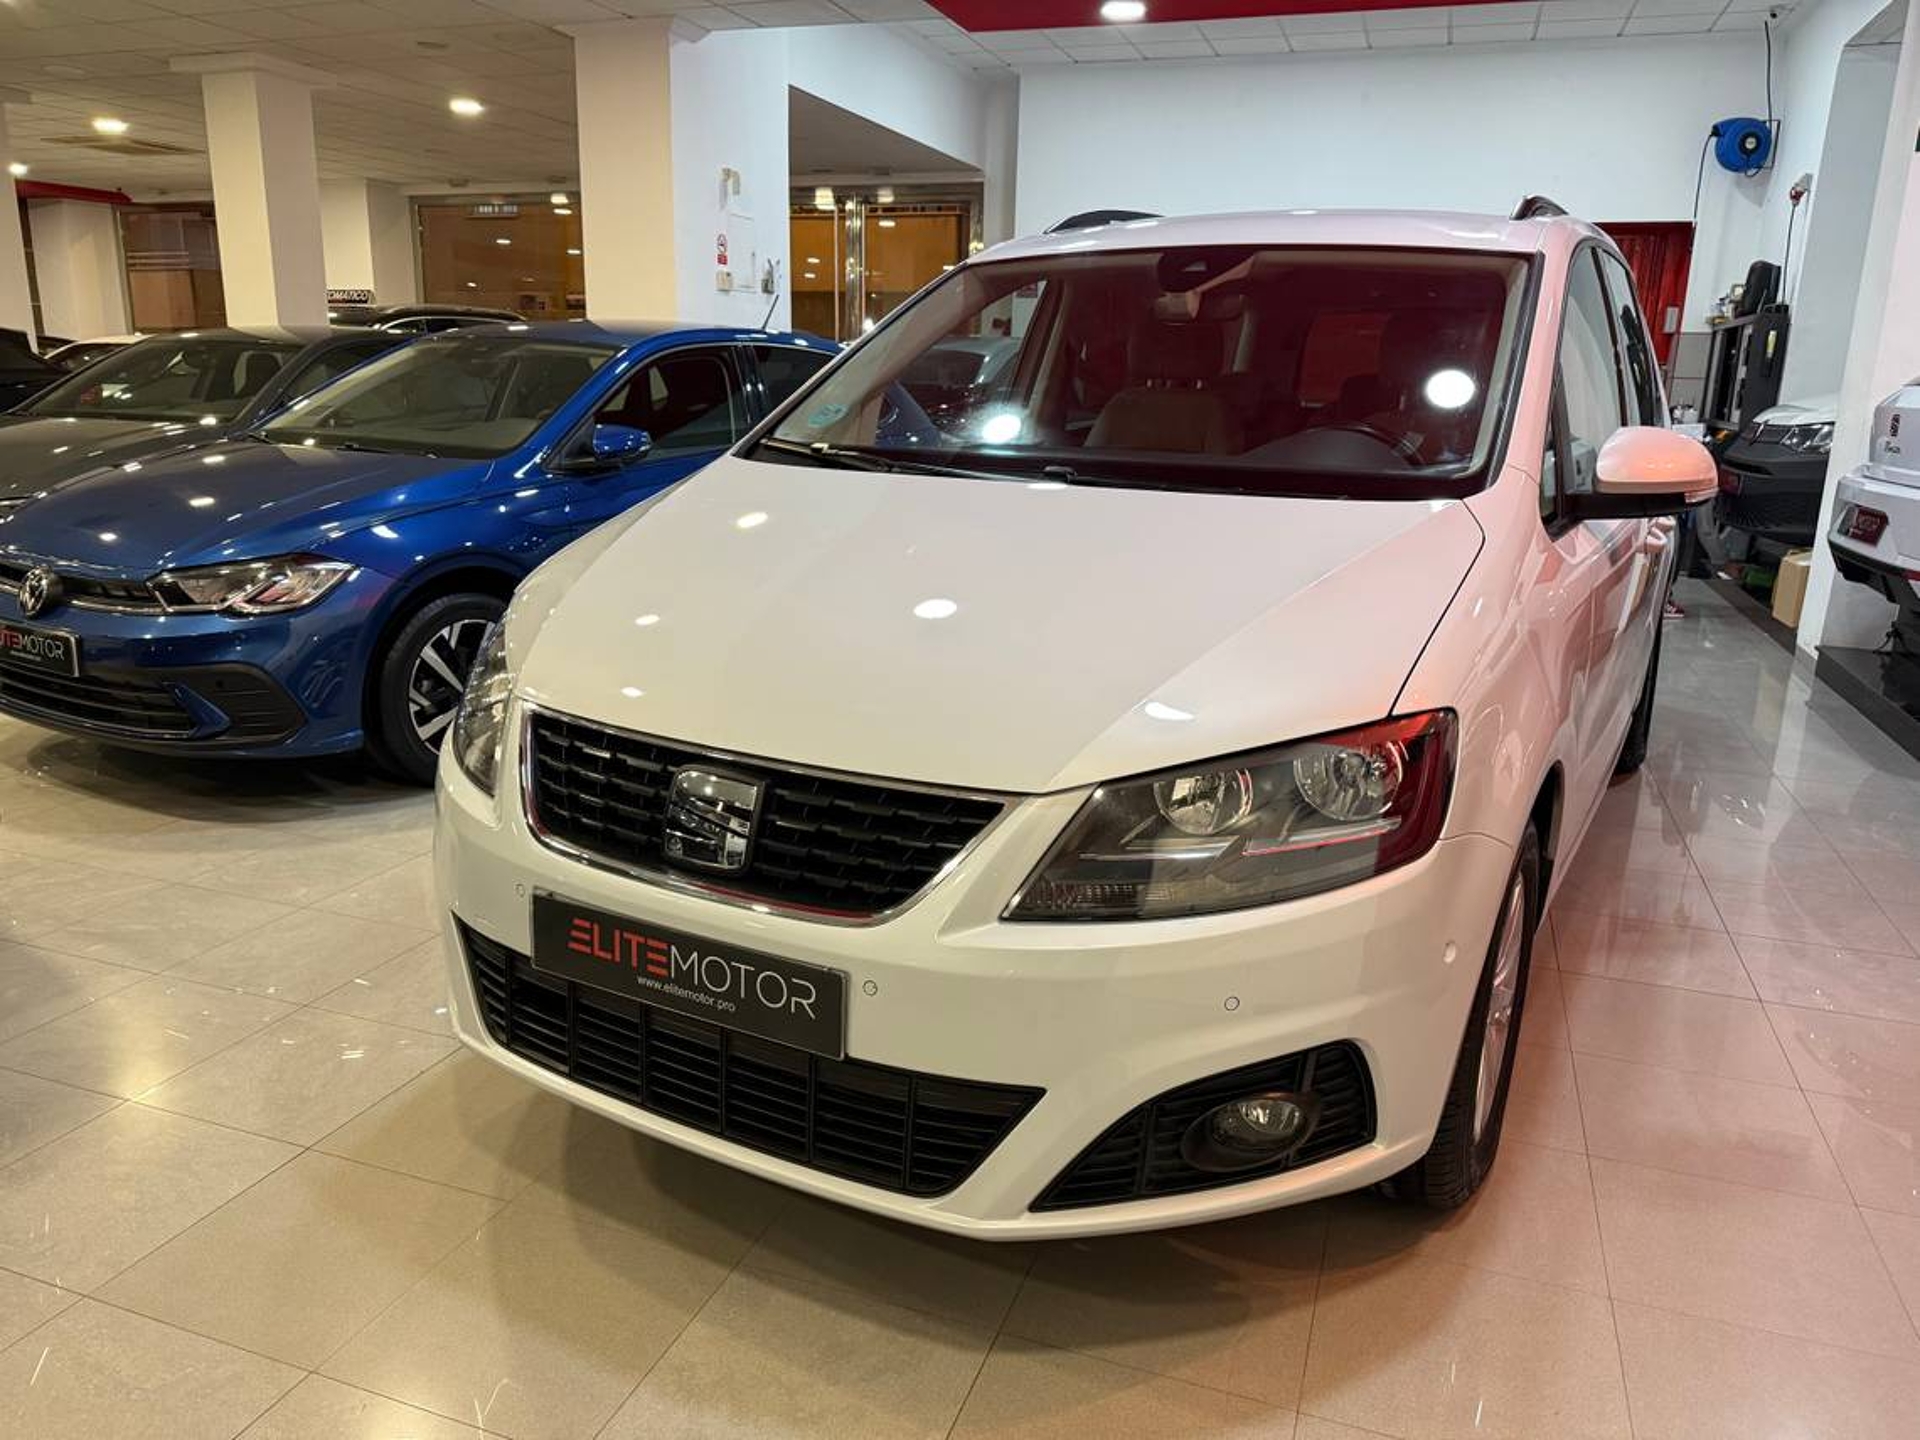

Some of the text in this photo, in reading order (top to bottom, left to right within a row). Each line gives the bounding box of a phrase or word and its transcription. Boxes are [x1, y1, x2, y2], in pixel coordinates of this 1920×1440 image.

[0, 629, 65, 661] ITEMOTOR
[567, 917, 817, 1020] ELITEMOTOR
[637, 975, 736, 1012] www.elitemotor.pro
